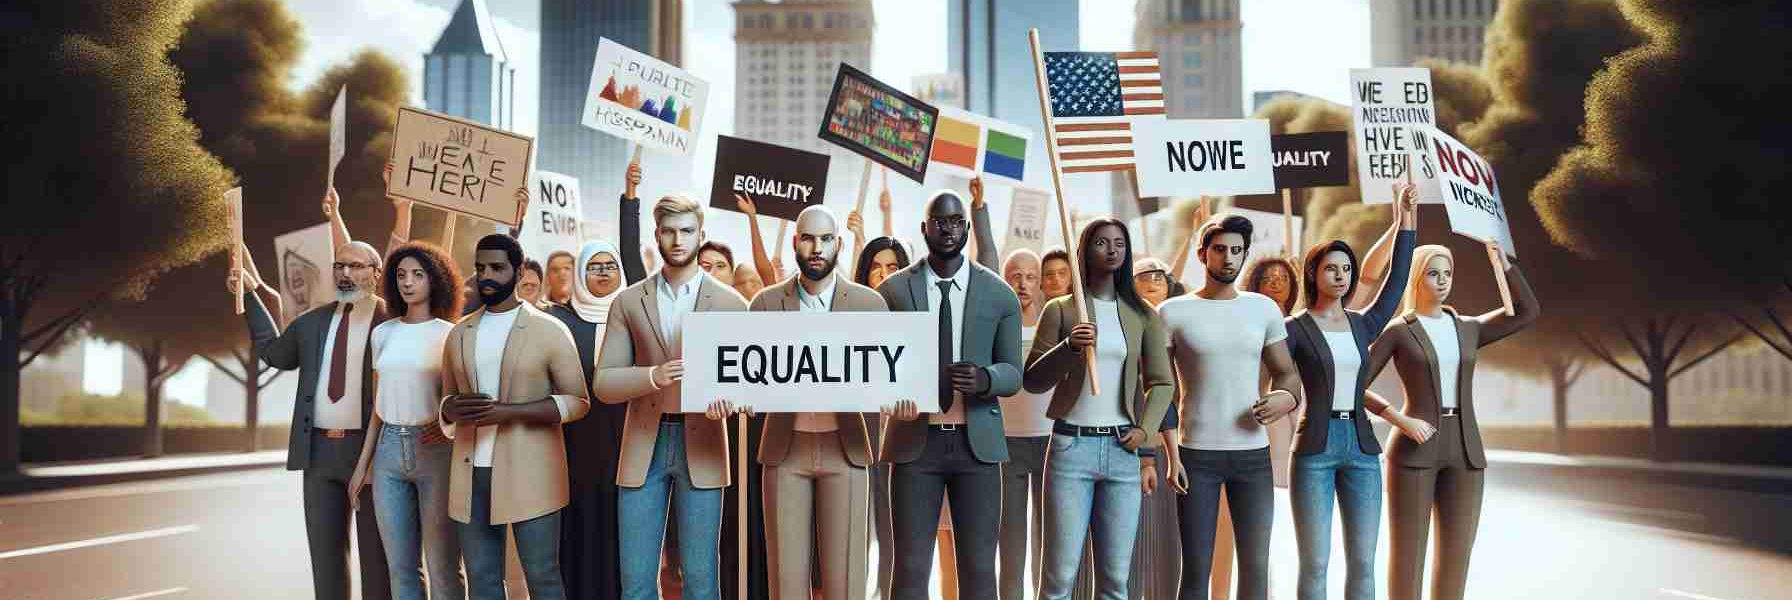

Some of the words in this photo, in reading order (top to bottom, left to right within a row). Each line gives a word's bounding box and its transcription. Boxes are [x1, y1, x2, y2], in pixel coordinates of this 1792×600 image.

[1166, 140, 1246, 172] NOWE
[1270, 150, 1331, 168] UALITY
[717, 345, 904, 385] EQUALITY
